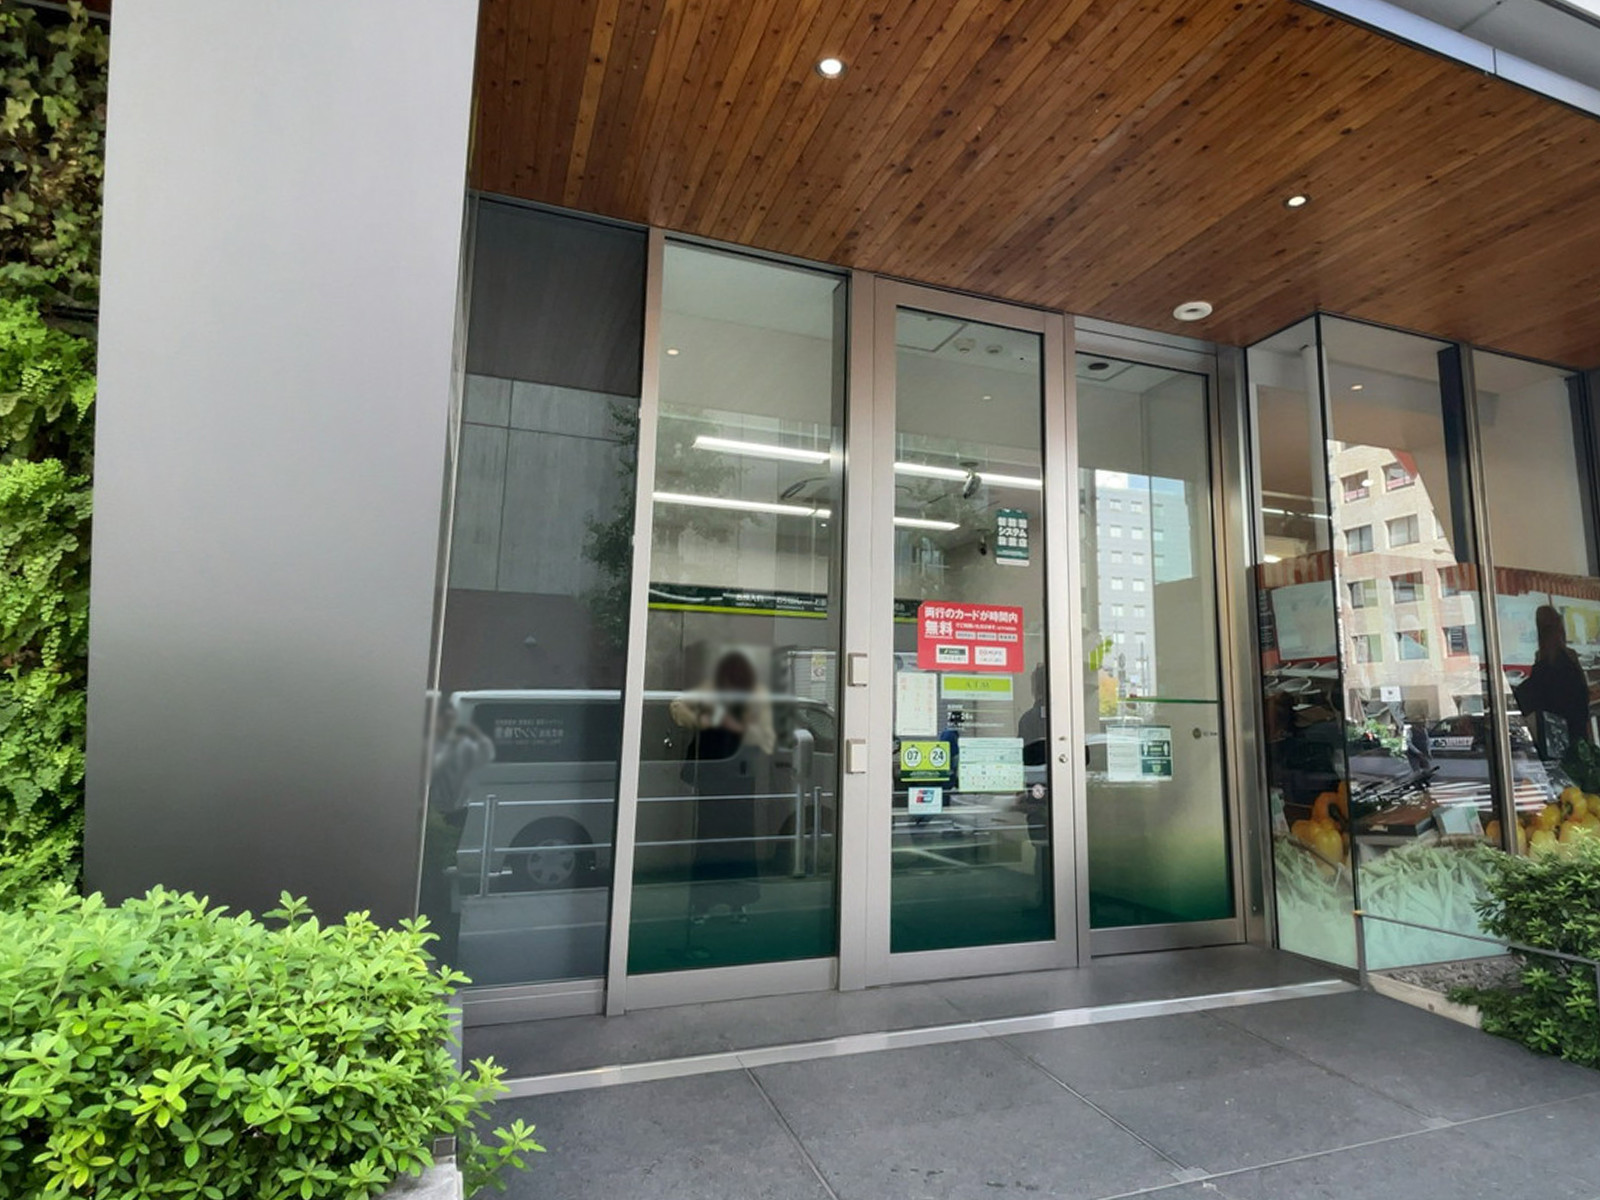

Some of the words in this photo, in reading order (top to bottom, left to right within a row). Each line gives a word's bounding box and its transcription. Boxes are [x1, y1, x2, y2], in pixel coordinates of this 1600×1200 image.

[924, 620, 953, 636] 無料
[906, 750, 919, 762] 07
[932, 750, 945, 762] 24
